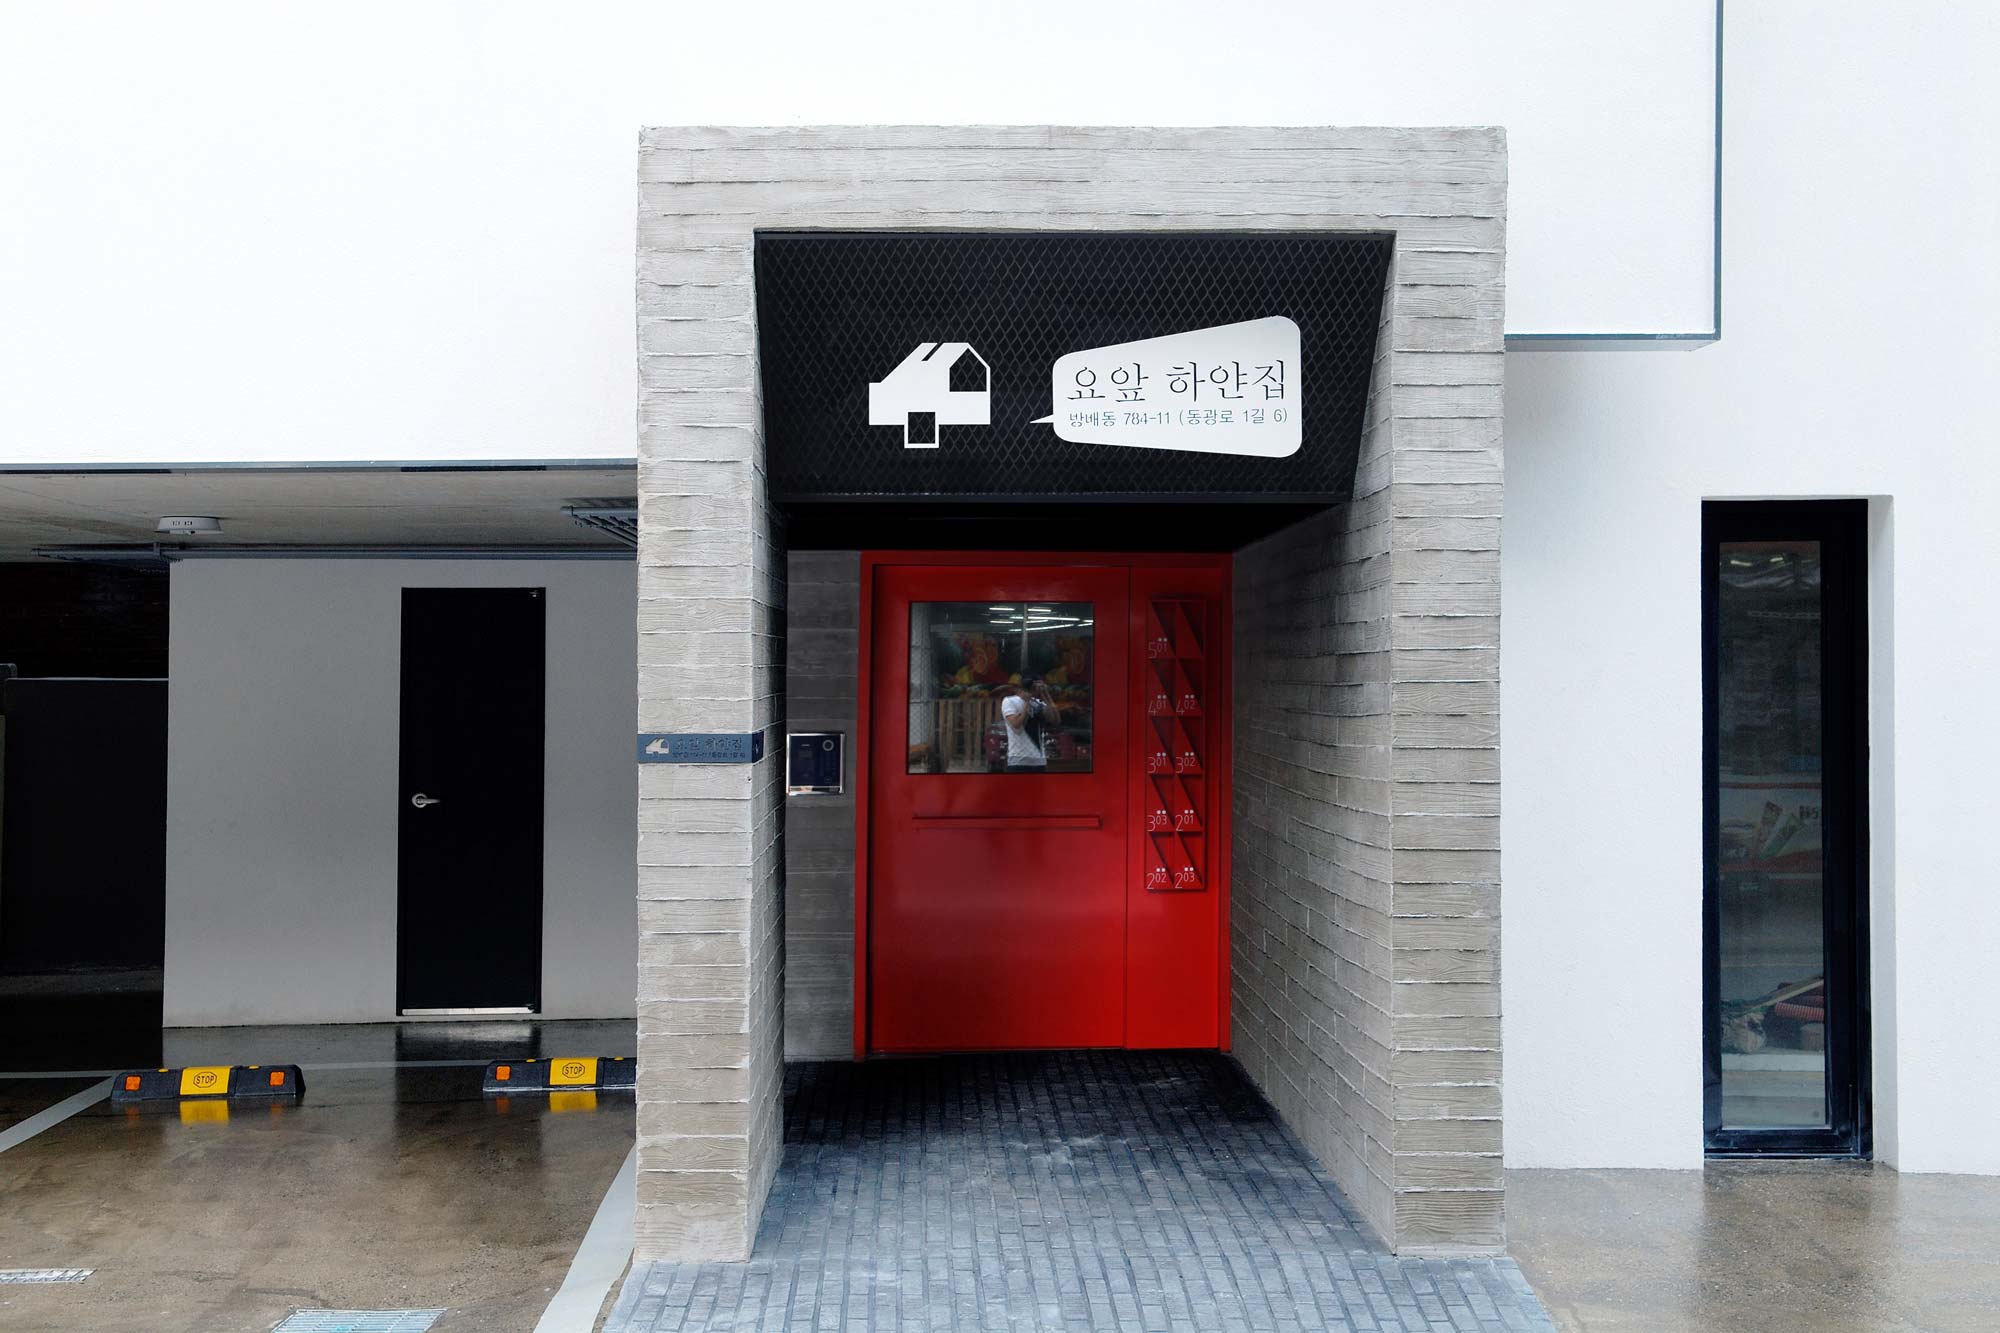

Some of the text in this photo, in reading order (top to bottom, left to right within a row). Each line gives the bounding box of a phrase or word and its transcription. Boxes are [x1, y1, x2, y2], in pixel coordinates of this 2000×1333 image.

[1067, 360, 1286, 403] 요앞 하얀집
[1069, 408, 1288, 427] 방배동 784-11 (동광로 1길 6)
[1148, 642, 1167, 659] 501
[1148, 700, 1167, 715] 401
[1176, 700, 1195, 715] 402
[1148, 757, 1167, 774] 301
[1175, 757, 1196, 774] 302
[1147, 815, 1168, 832] 303
[1175, 814, 1194, 831] 201
[1146, 873, 1167, 889] 202
[1175, 872, 1195, 889] 203
[565, 1066, 583, 1074] STOP
[196, 1076, 214, 1084] STOP
